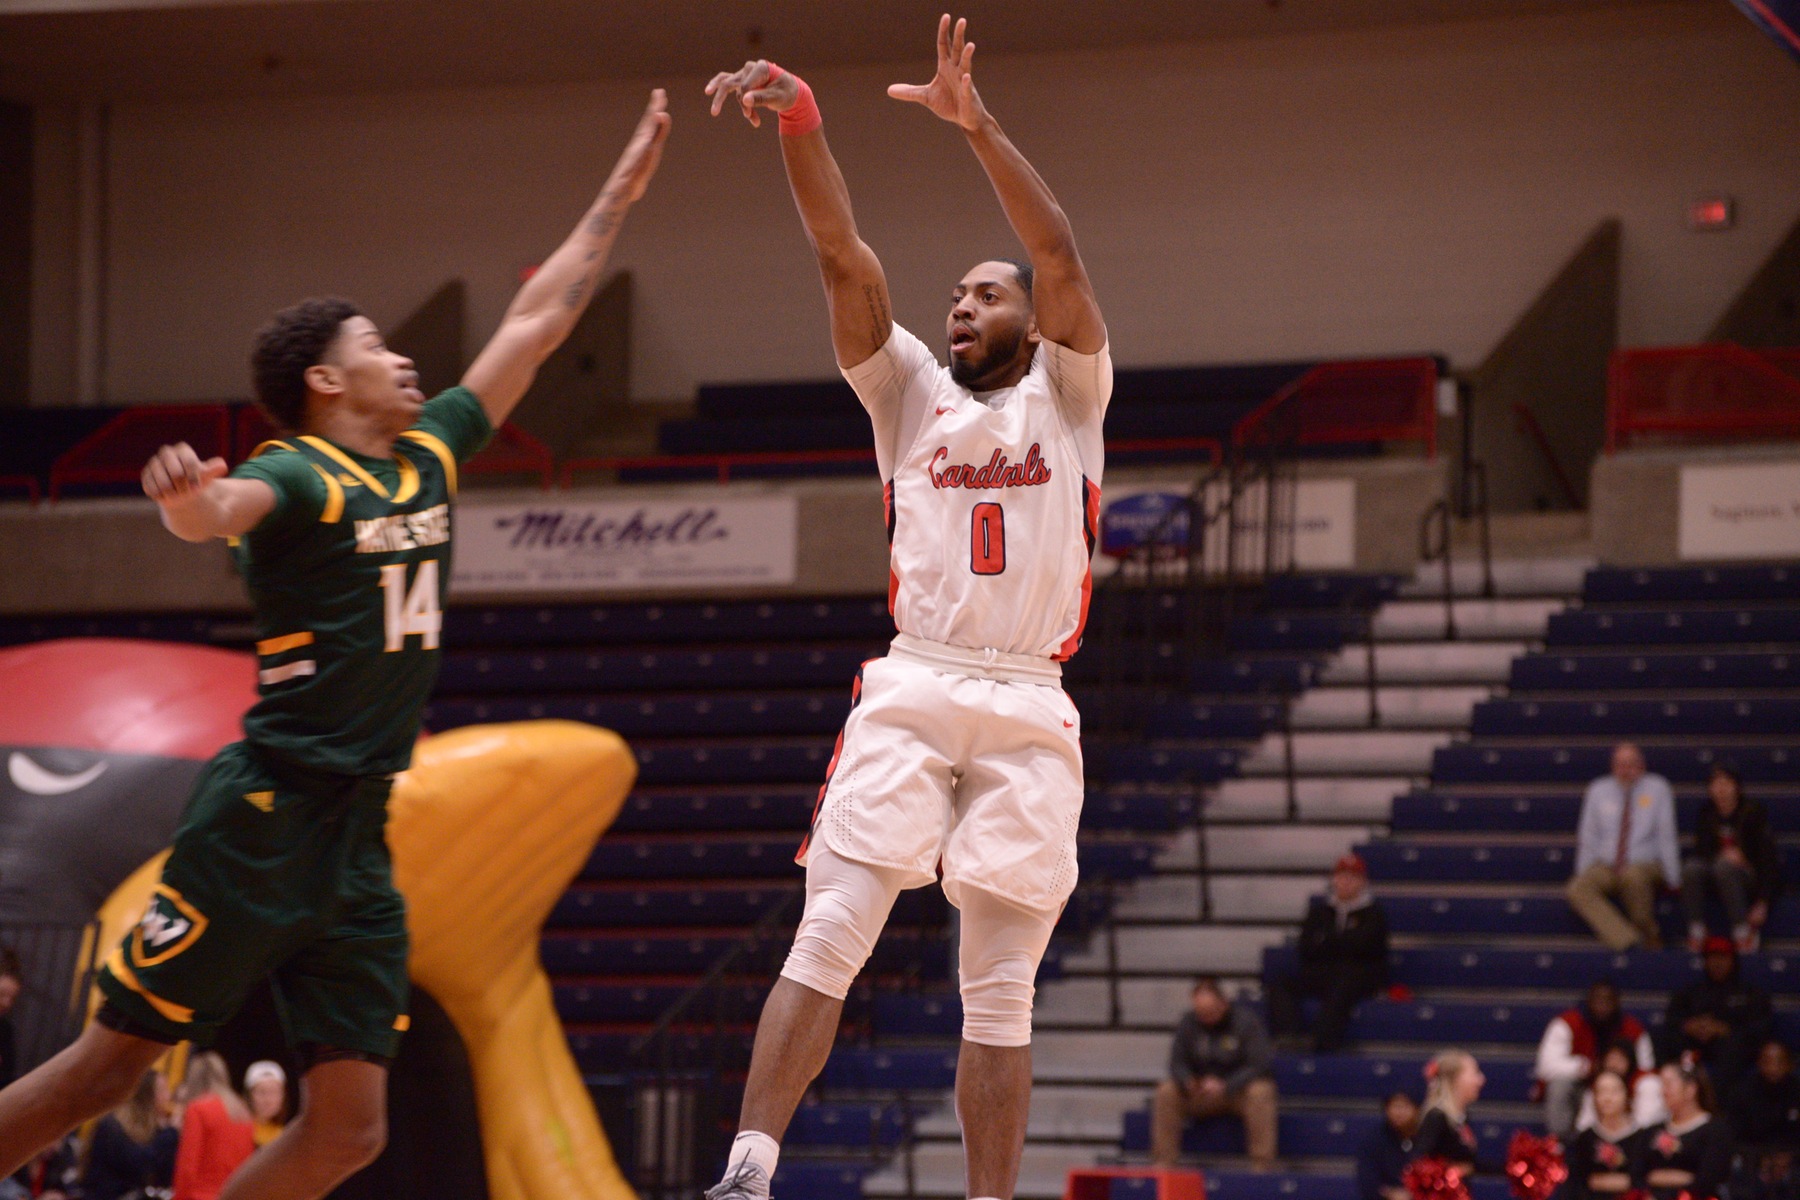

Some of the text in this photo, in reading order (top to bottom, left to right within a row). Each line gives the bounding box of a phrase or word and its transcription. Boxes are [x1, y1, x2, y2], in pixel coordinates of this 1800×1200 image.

[928, 442, 1052, 489] Cardinals
[494, 508, 729, 548] Mitchell
[970, 502, 1006, 575] 0
[377, 559, 443, 652] 14
